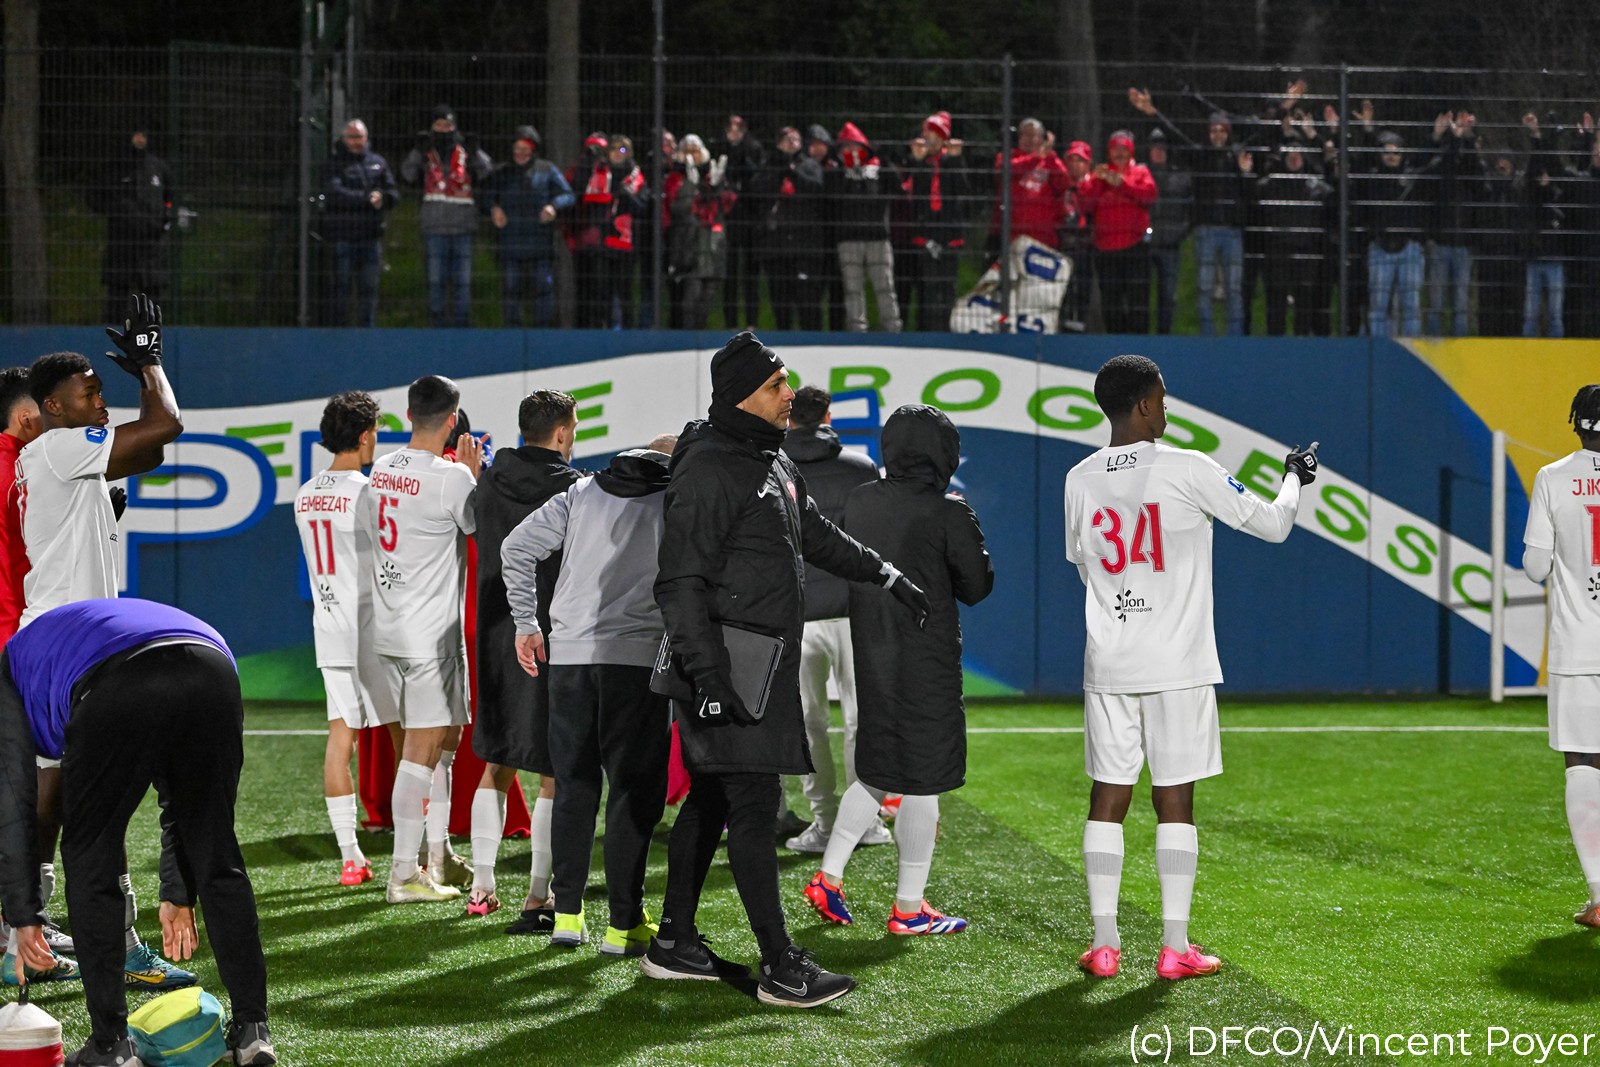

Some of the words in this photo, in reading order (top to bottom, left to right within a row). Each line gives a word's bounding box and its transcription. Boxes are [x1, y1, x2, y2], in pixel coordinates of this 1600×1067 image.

[1107, 451, 1138, 467] LDS
[371, 471, 420, 496] BERNARD
[296, 495, 352, 514] LEMBEZAT
[378, 495, 400, 553] 5
[308, 519, 337, 576] 11
[1091, 502, 1165, 576] 34
